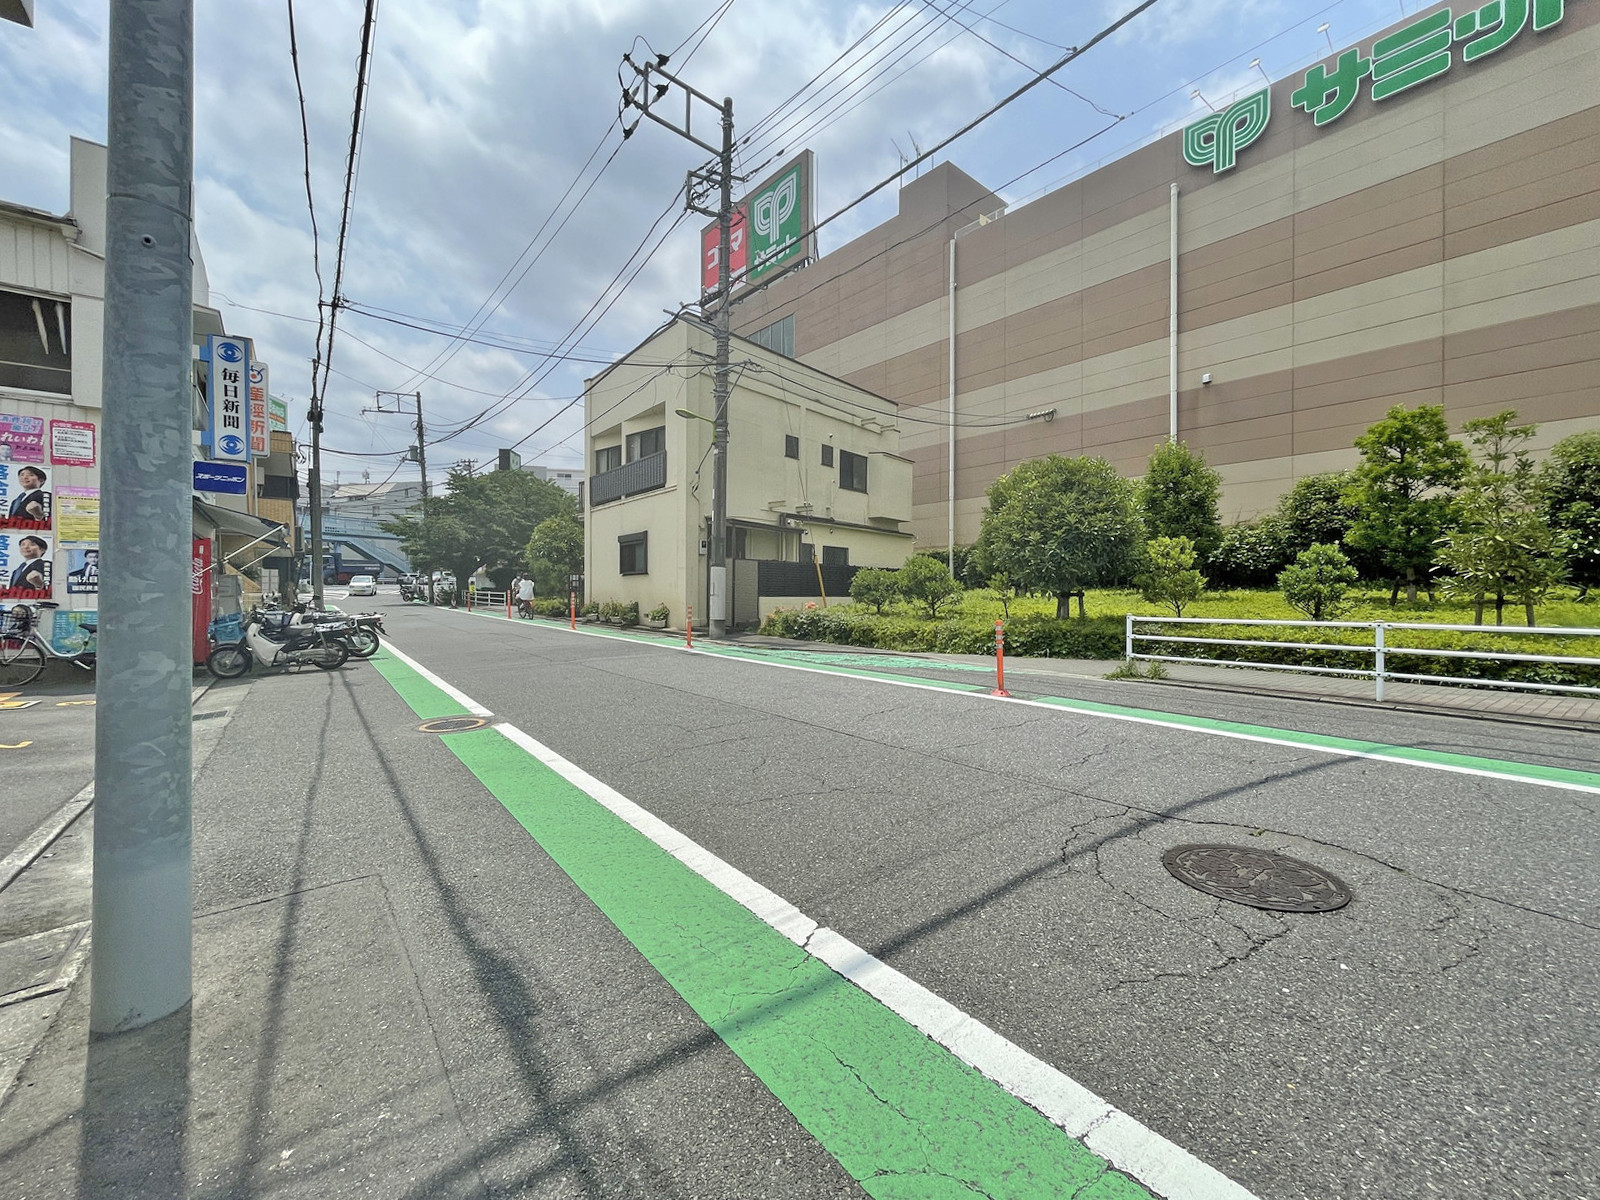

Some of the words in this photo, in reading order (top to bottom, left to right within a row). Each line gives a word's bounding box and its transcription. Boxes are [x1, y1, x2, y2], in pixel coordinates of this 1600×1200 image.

[1291, 0, 1564, 127] サミッ
[221, 367, 240, 430] 毎日新聞
